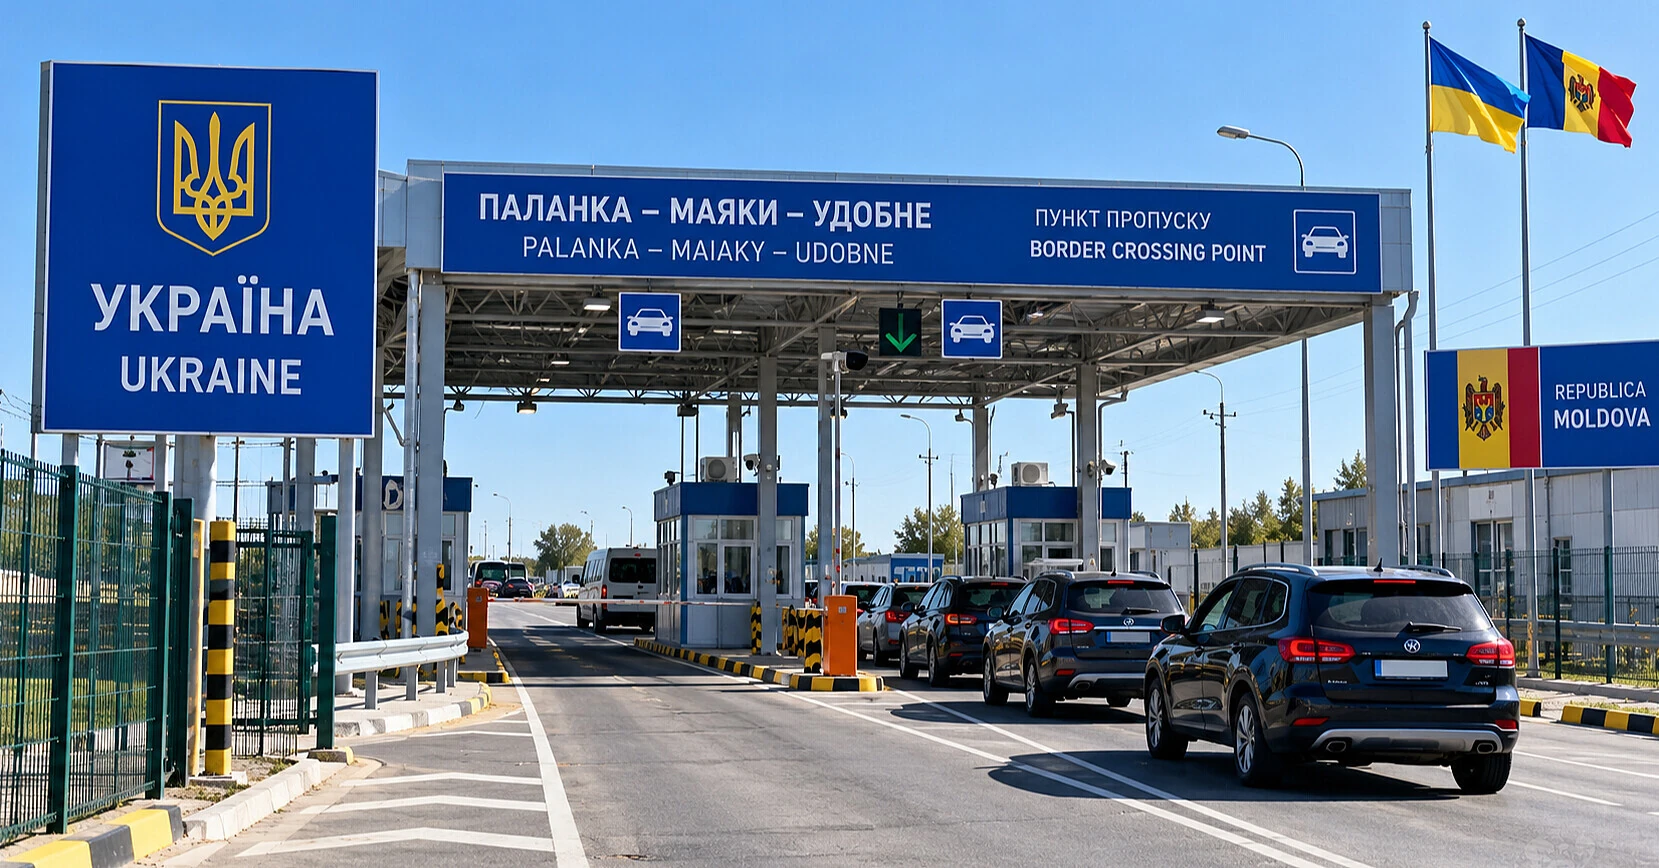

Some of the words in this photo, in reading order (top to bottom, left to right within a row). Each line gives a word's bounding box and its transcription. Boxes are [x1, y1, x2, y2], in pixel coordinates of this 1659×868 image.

[479, 193, 633, 223] ПАЛАНКА
[670, 197, 777, 226] МАЯКИ
[812, 200, 932, 233] УДОБНЕ
[1036, 208, 1101, 228] ПУНКТ
[1107, 210, 1211, 230] ПРОПУСКУ
[523, 236, 639, 260] PALANKA
[672, 239, 765, 262] MAIAKY
[796, 241, 894, 265] UDOBNE
[1030, 240, 1106, 259] BORDER
[1112, 241, 1206, 261] CROSSING
[1211, 243, 1267, 263] POINT
[90, 274, 335, 336] УКРАЇНА
[121, 355, 302, 395] UKRAINE
[1555, 380, 1647, 401] REPUBLICA
[1554, 407, 1651, 429] MOLDOVA
